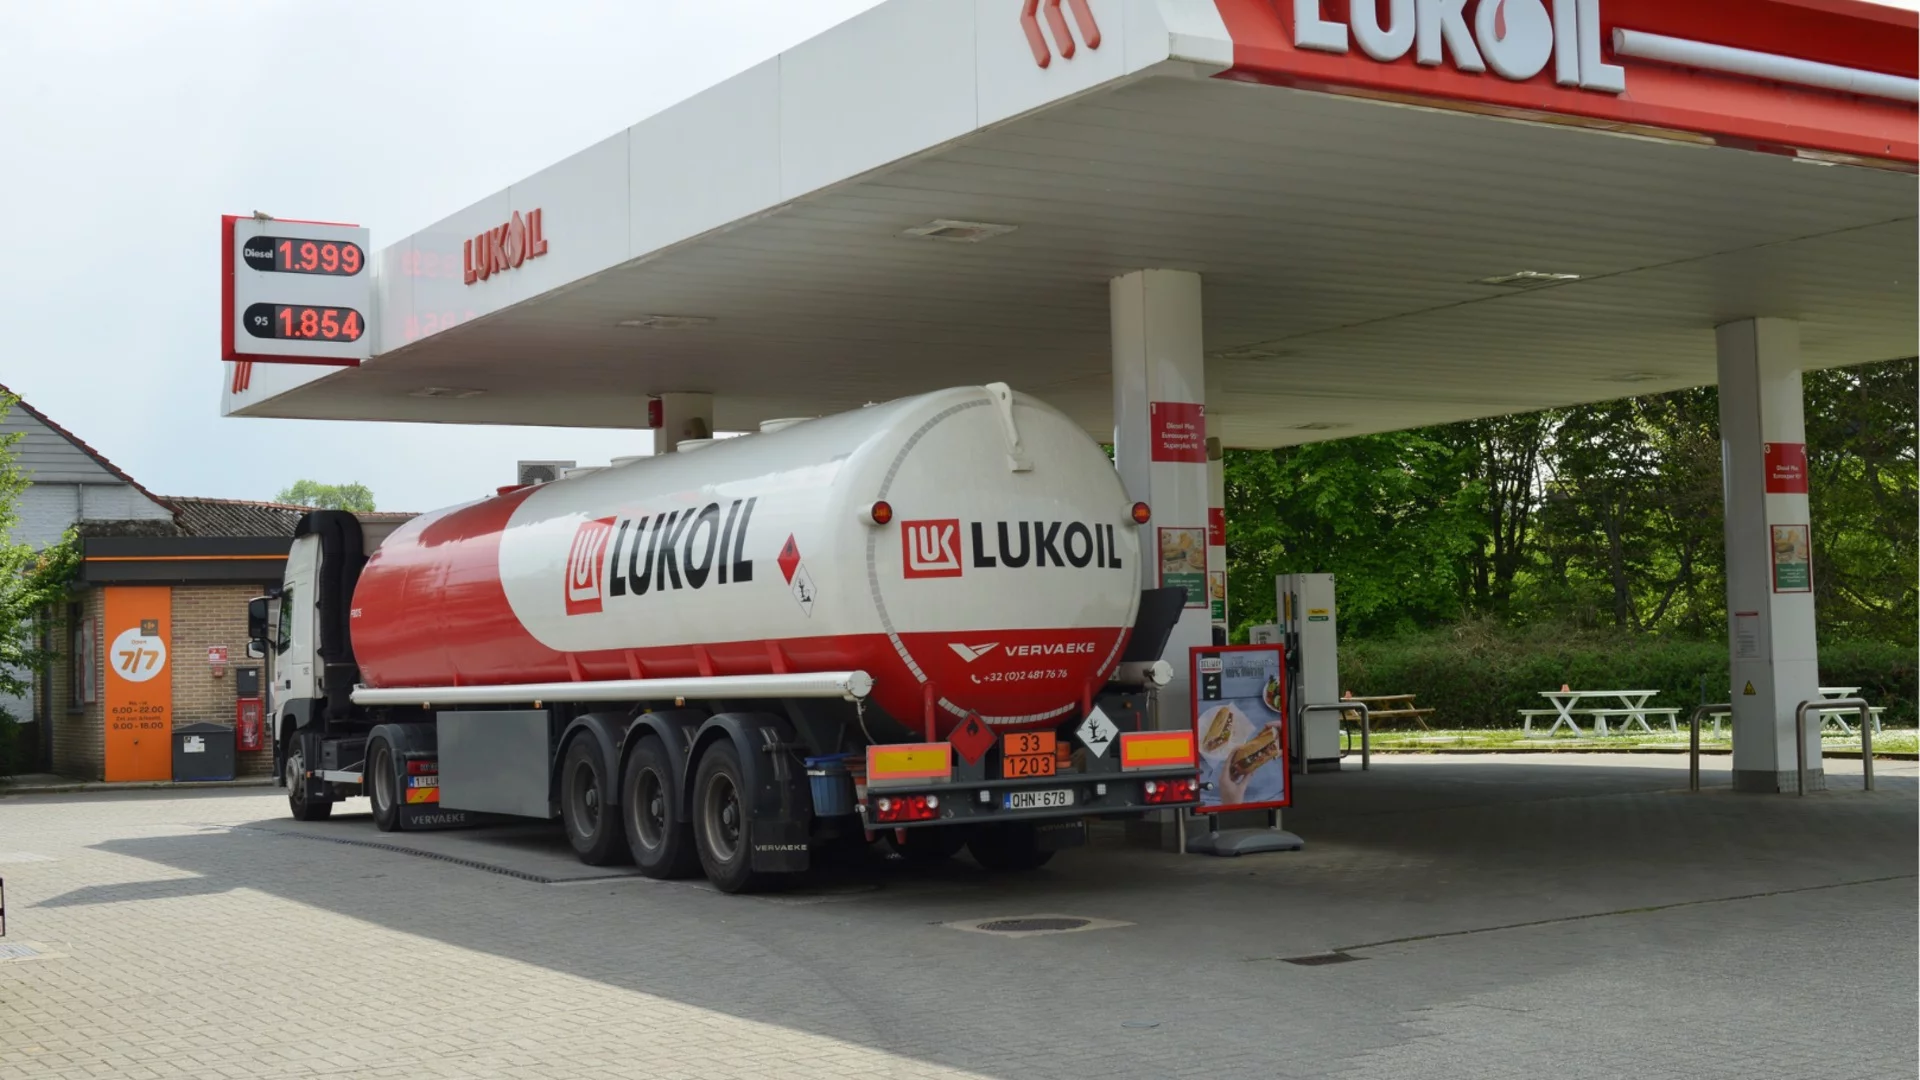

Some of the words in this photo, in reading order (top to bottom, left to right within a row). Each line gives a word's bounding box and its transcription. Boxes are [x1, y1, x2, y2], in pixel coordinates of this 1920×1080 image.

[1293, 0, 1626, 93] LUKOIL
[464, 207, 547, 286] LUKOIL
[244, 248, 274, 259] Diesel
[280, 240, 360, 273] 1.999
[254, 316, 268, 326] 95
[280, 307, 360, 339] 1.854
[1151, 403, 1157, 415] 1
[1199, 405, 1204, 417] 2
[1764, 444, 1770, 454] 3
[610, 496, 758, 597] LUKOIL
[907, 523, 960, 572] LUK
[971, 521, 1122, 569] LUKOIL
[1005, 642, 1096, 656] VERVAEKE
[118, 647, 160, 674] 7/7
[984, 672, 1002, 682] +32
[1004, 671, 1026, 682] (0)2
[1028, 670, 1043, 679] 481
[1046, 669, 1056, 679] 76
[1058, 668, 1068, 678] 76
[139, 706, 164, 714] 22.00
[1020, 735, 1040, 752] 33
[1009, 756, 1050, 775] 1203
[416, 775, 439, 786] 1-LU
[411, 814, 465, 825] VERVAEKE
